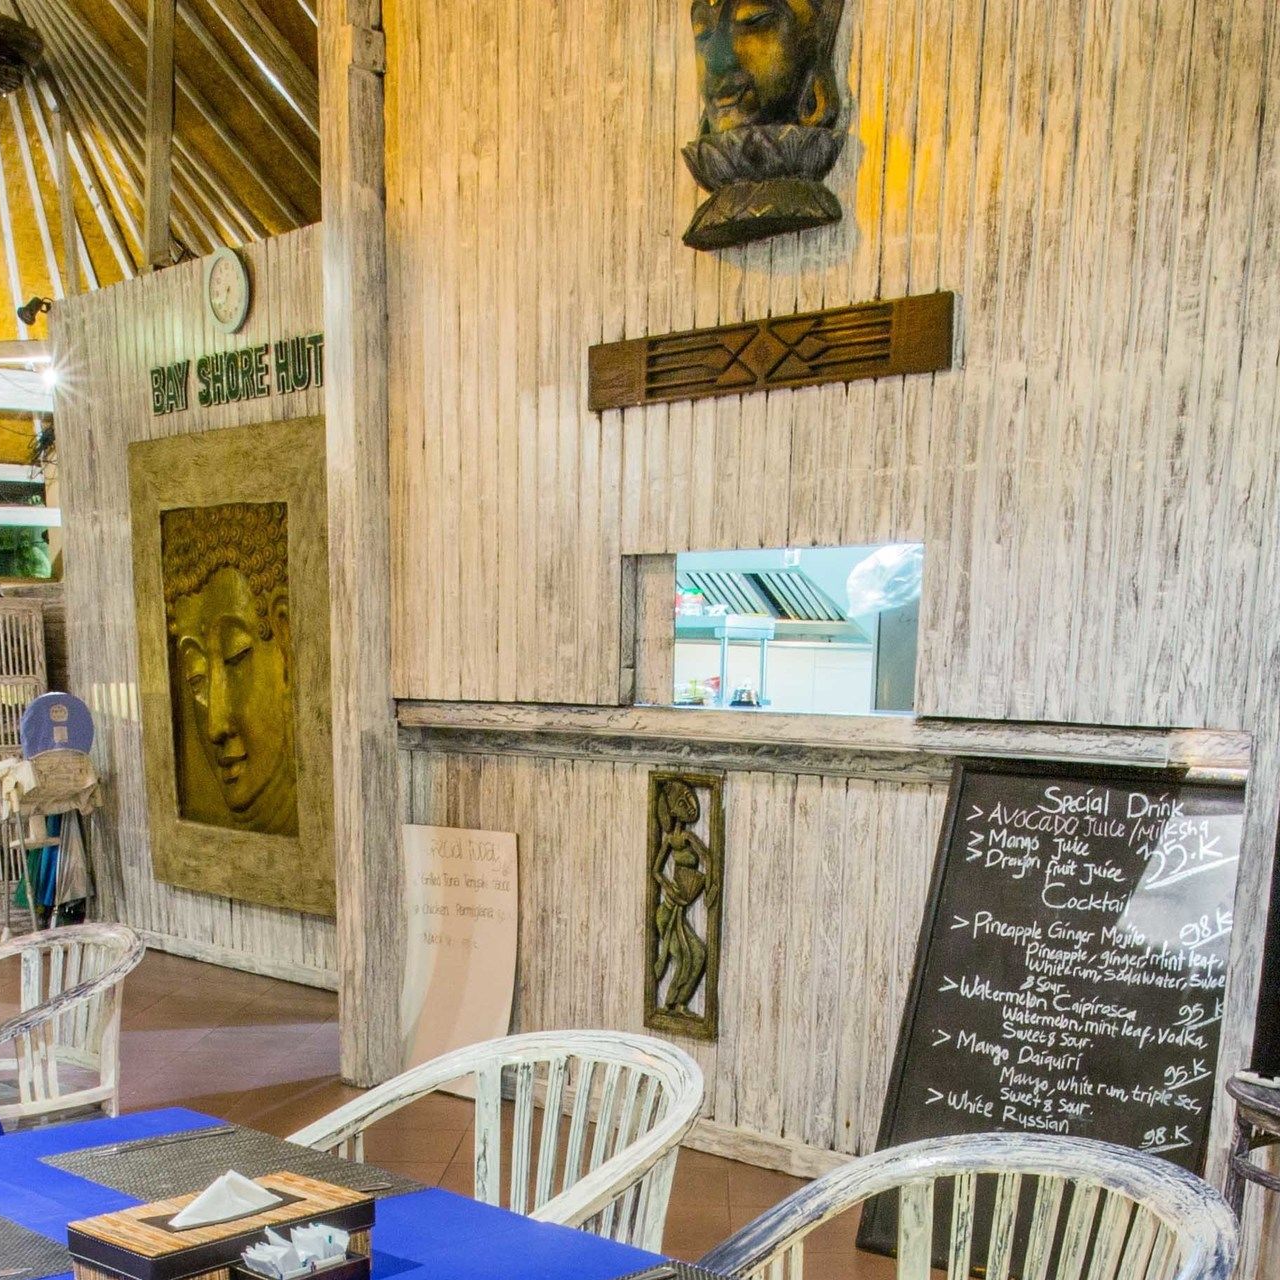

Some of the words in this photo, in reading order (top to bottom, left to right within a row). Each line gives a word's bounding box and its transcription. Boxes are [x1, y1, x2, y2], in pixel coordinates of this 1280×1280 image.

[150, 359, 191, 416] BAY
[196, 343, 271, 407] SHORE
[274, 333, 324, 395] HUT
[1037, 786, 1109, 817] Special
[1127, 792, 1184, 818] Drink
[989, 828, 1040, 859] Mango
[985, 848, 1041, 879] Dragon
[1042, 882, 1133, 918] Cocktail
[973, 911, 1042, 946] Pineapple
[1048, 921, 1095, 950] Ginger
[960, 975, 1047, 1010] Watermelon
[1053, 994, 1137, 1021] Caipirosca
[1085, 1020, 1119, 1037] mint
[956, 1030, 1009, 1065] Mango
[1017, 1045, 1083, 1072] Daiquiri
[948, 1090, 994, 1117] White
[1002, 1105, 1069, 1134] Russian
[1000, 1086, 1041, 1109] Sweet
[1131, 1085, 1172, 1107] triple
